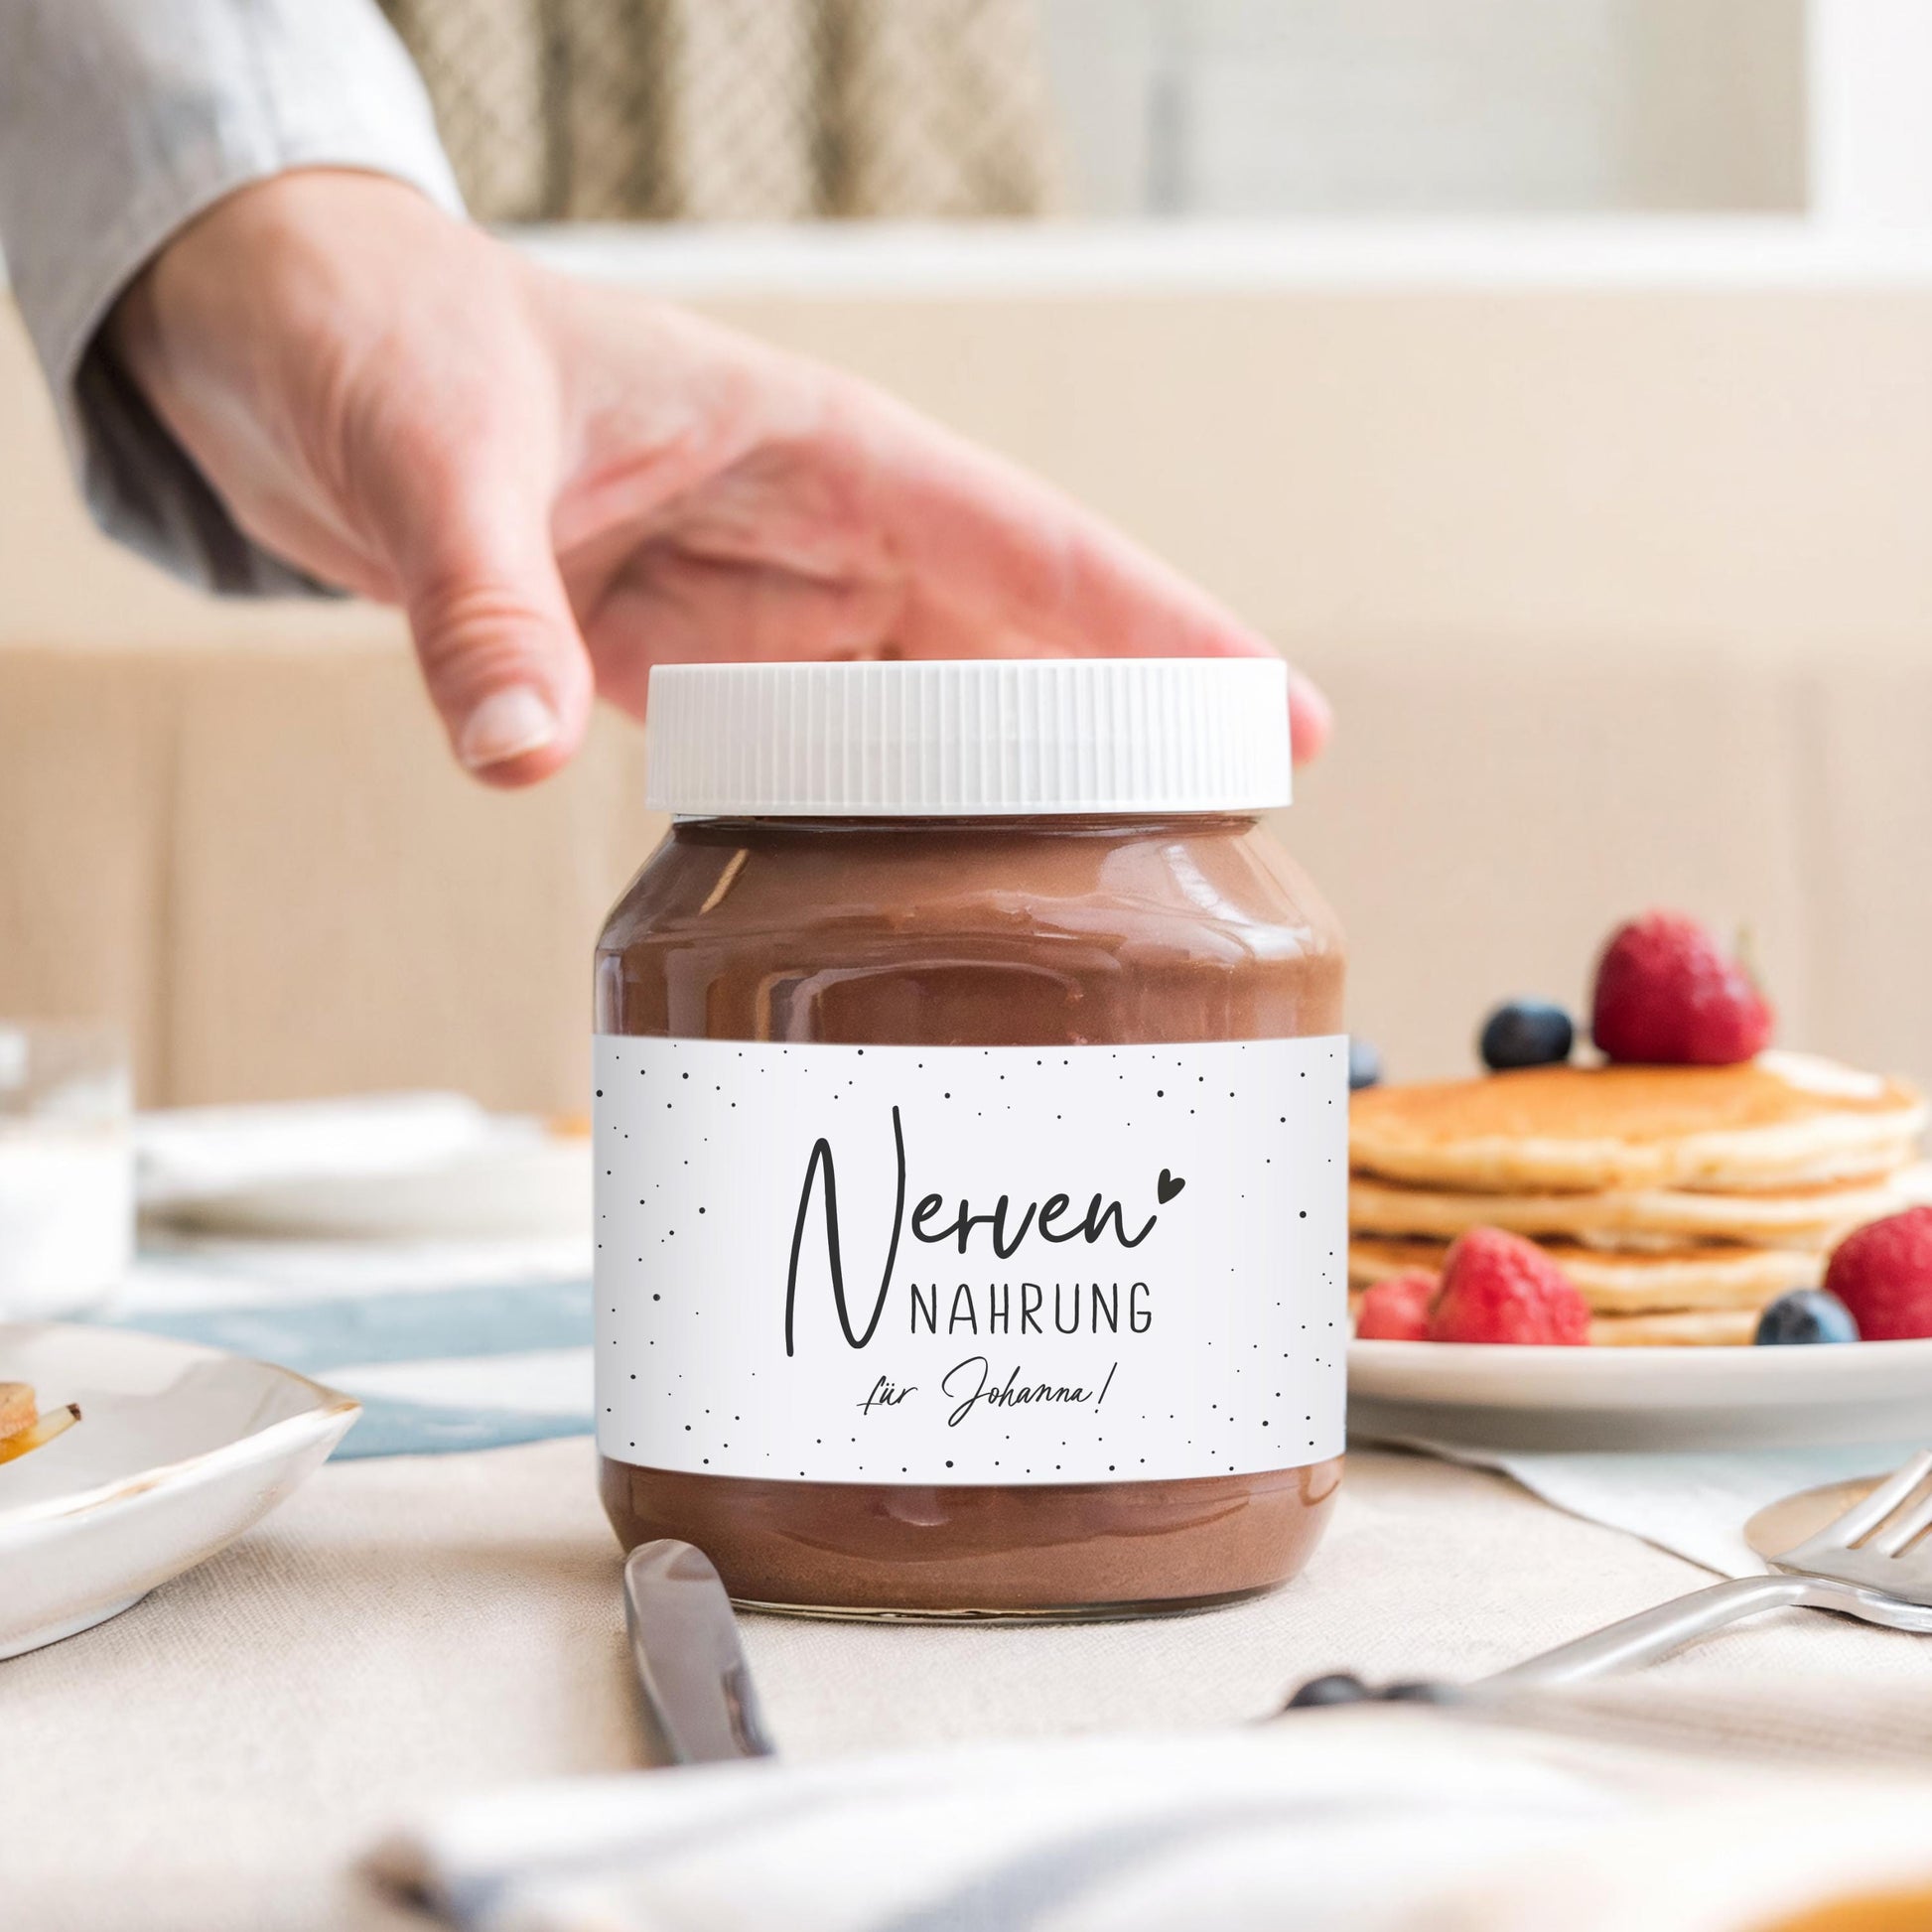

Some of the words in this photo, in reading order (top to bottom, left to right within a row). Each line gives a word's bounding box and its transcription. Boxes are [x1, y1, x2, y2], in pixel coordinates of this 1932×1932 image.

[785, 1106, 1158, 1357] Nerven
[911, 1282, 1152, 1335] NAHRUNG
[856, 1375, 918, 1416] für
[941, 1356, 1118, 1428] Johanna!
